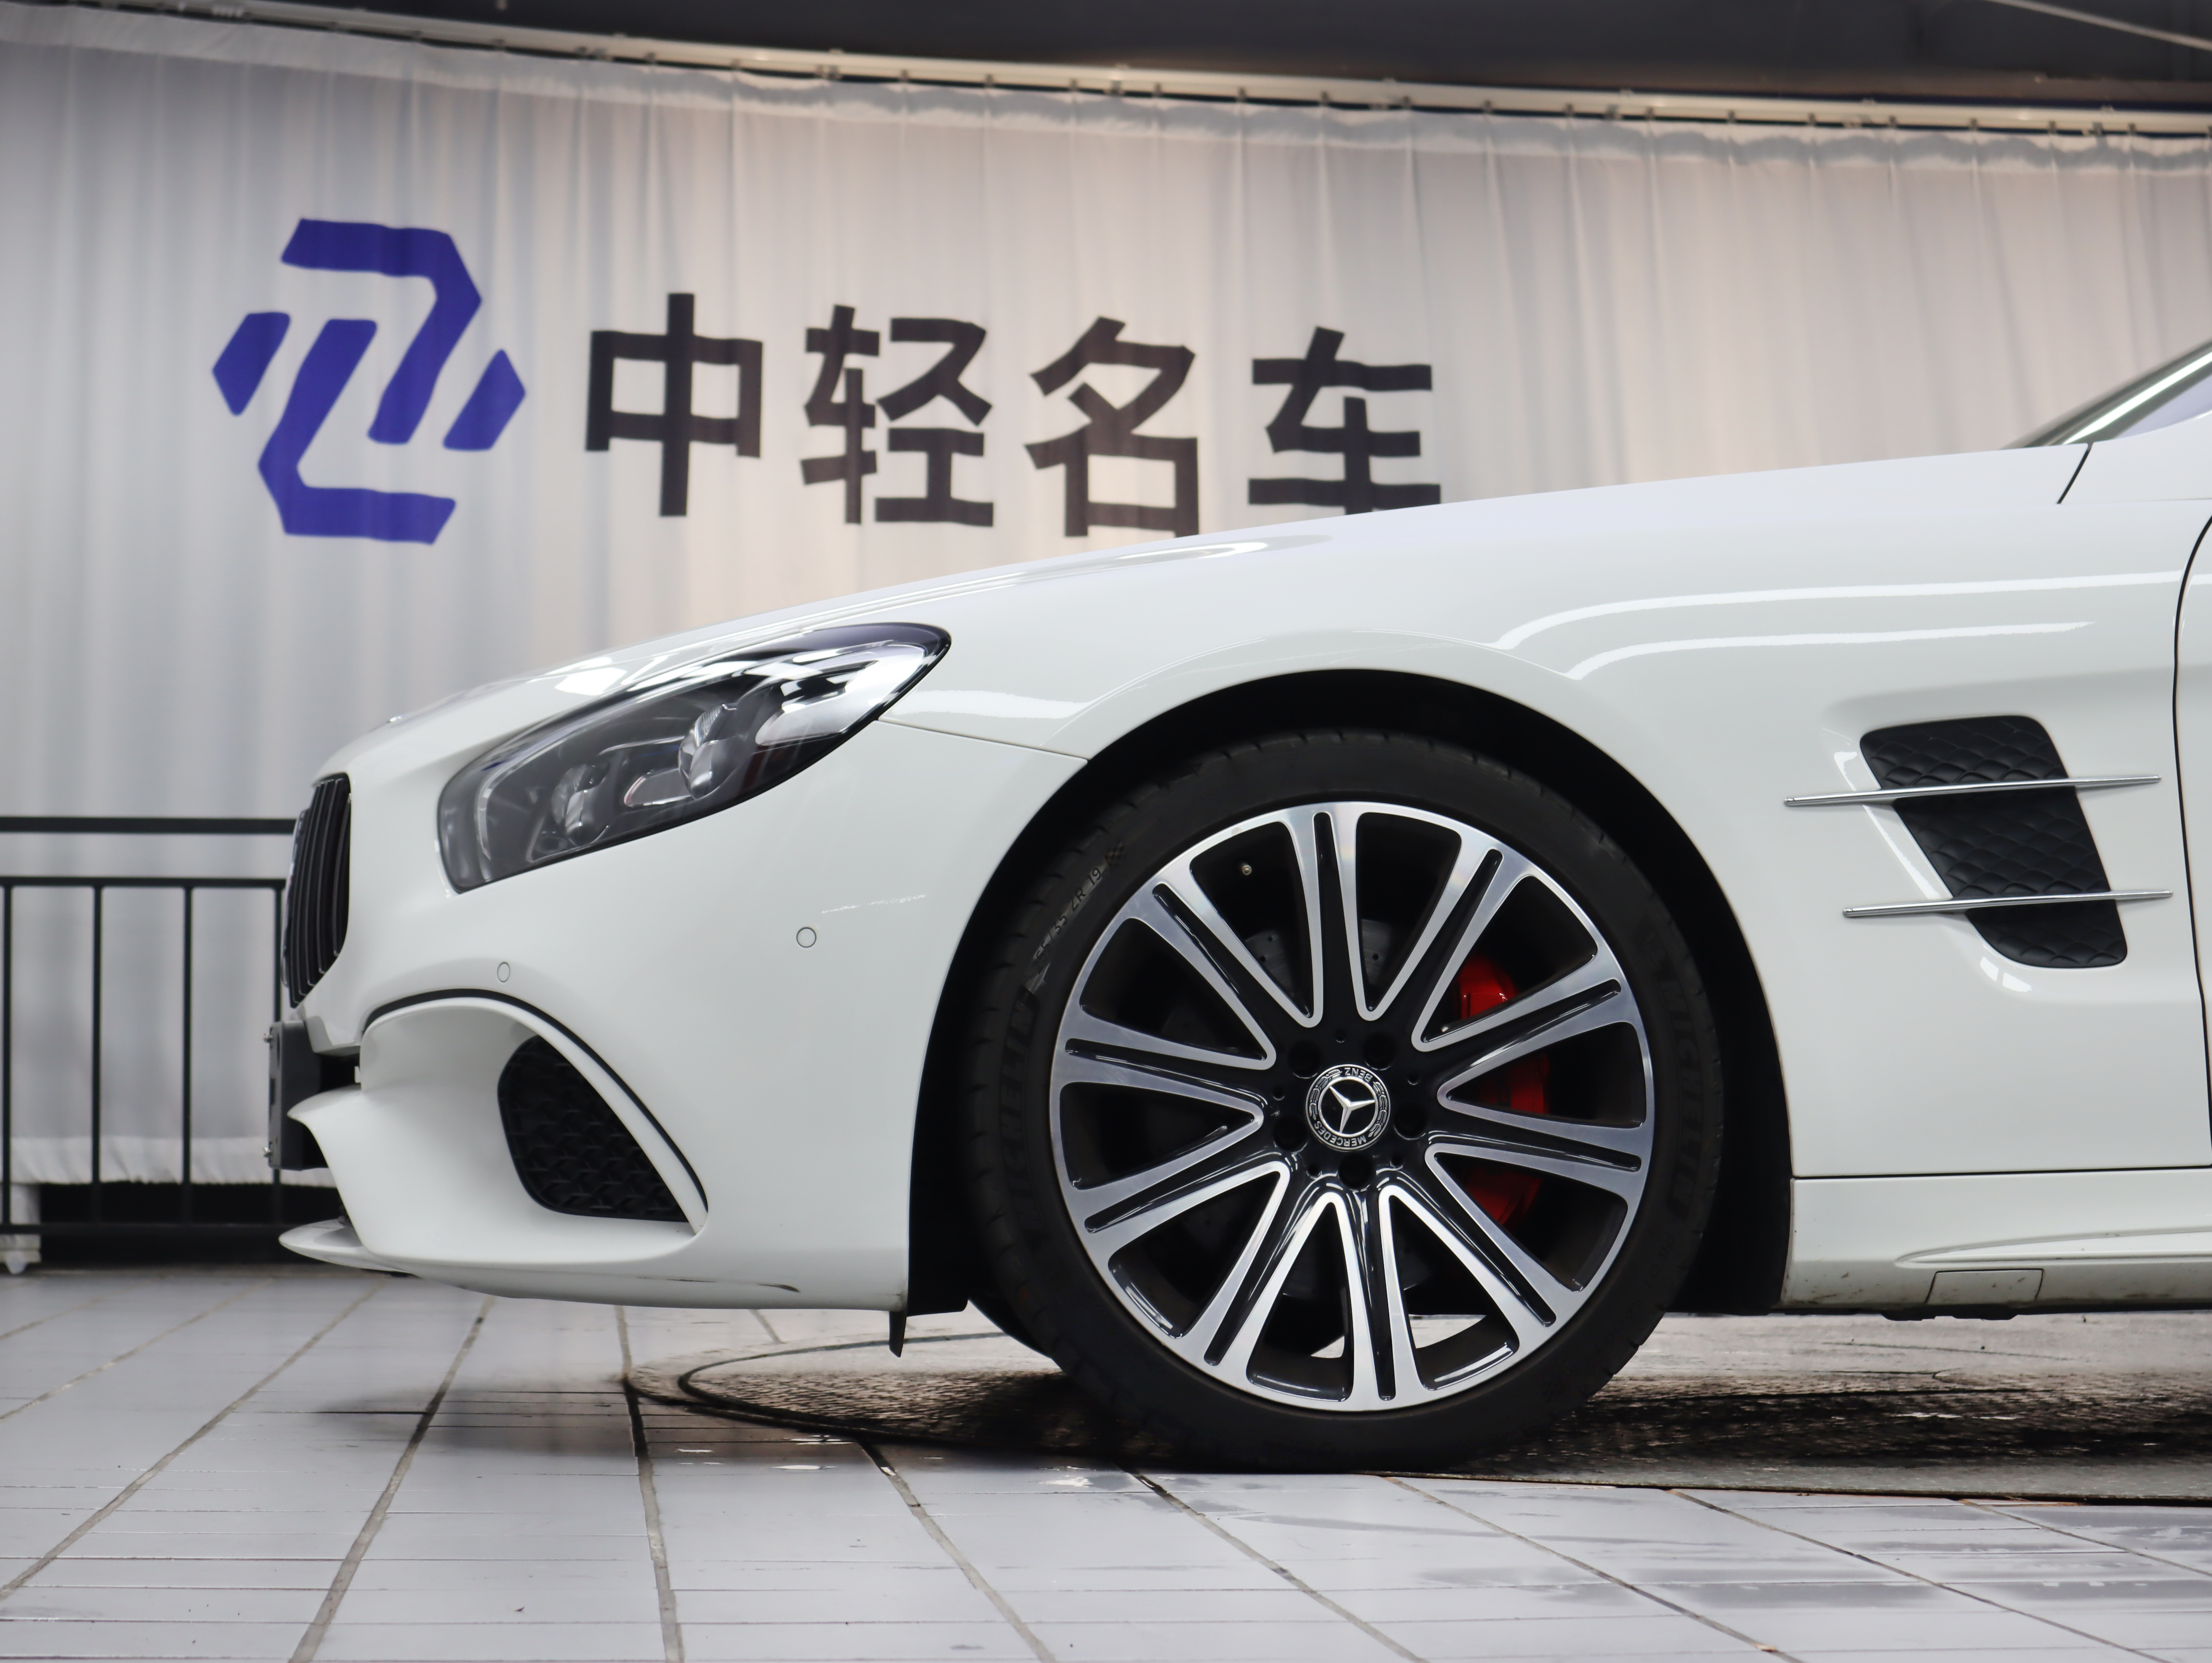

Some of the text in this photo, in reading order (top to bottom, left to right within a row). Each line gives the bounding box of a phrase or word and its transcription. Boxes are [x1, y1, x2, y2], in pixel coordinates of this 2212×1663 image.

[586, 294, 1440, 535] 中轻名车
[1070, 889, 1087, 913] ZR
[1087, 867, 1103, 885] 19
[1344, 1067, 1373, 1083] BENZ
[1660, 976, 1702, 1207] MICHELIN
[1002, 1001, 1043, 1232] MICHELIN
[1314, 1120, 1367, 1146] MERCEDES
[1646, 1233, 1675, 1290] PILOT
